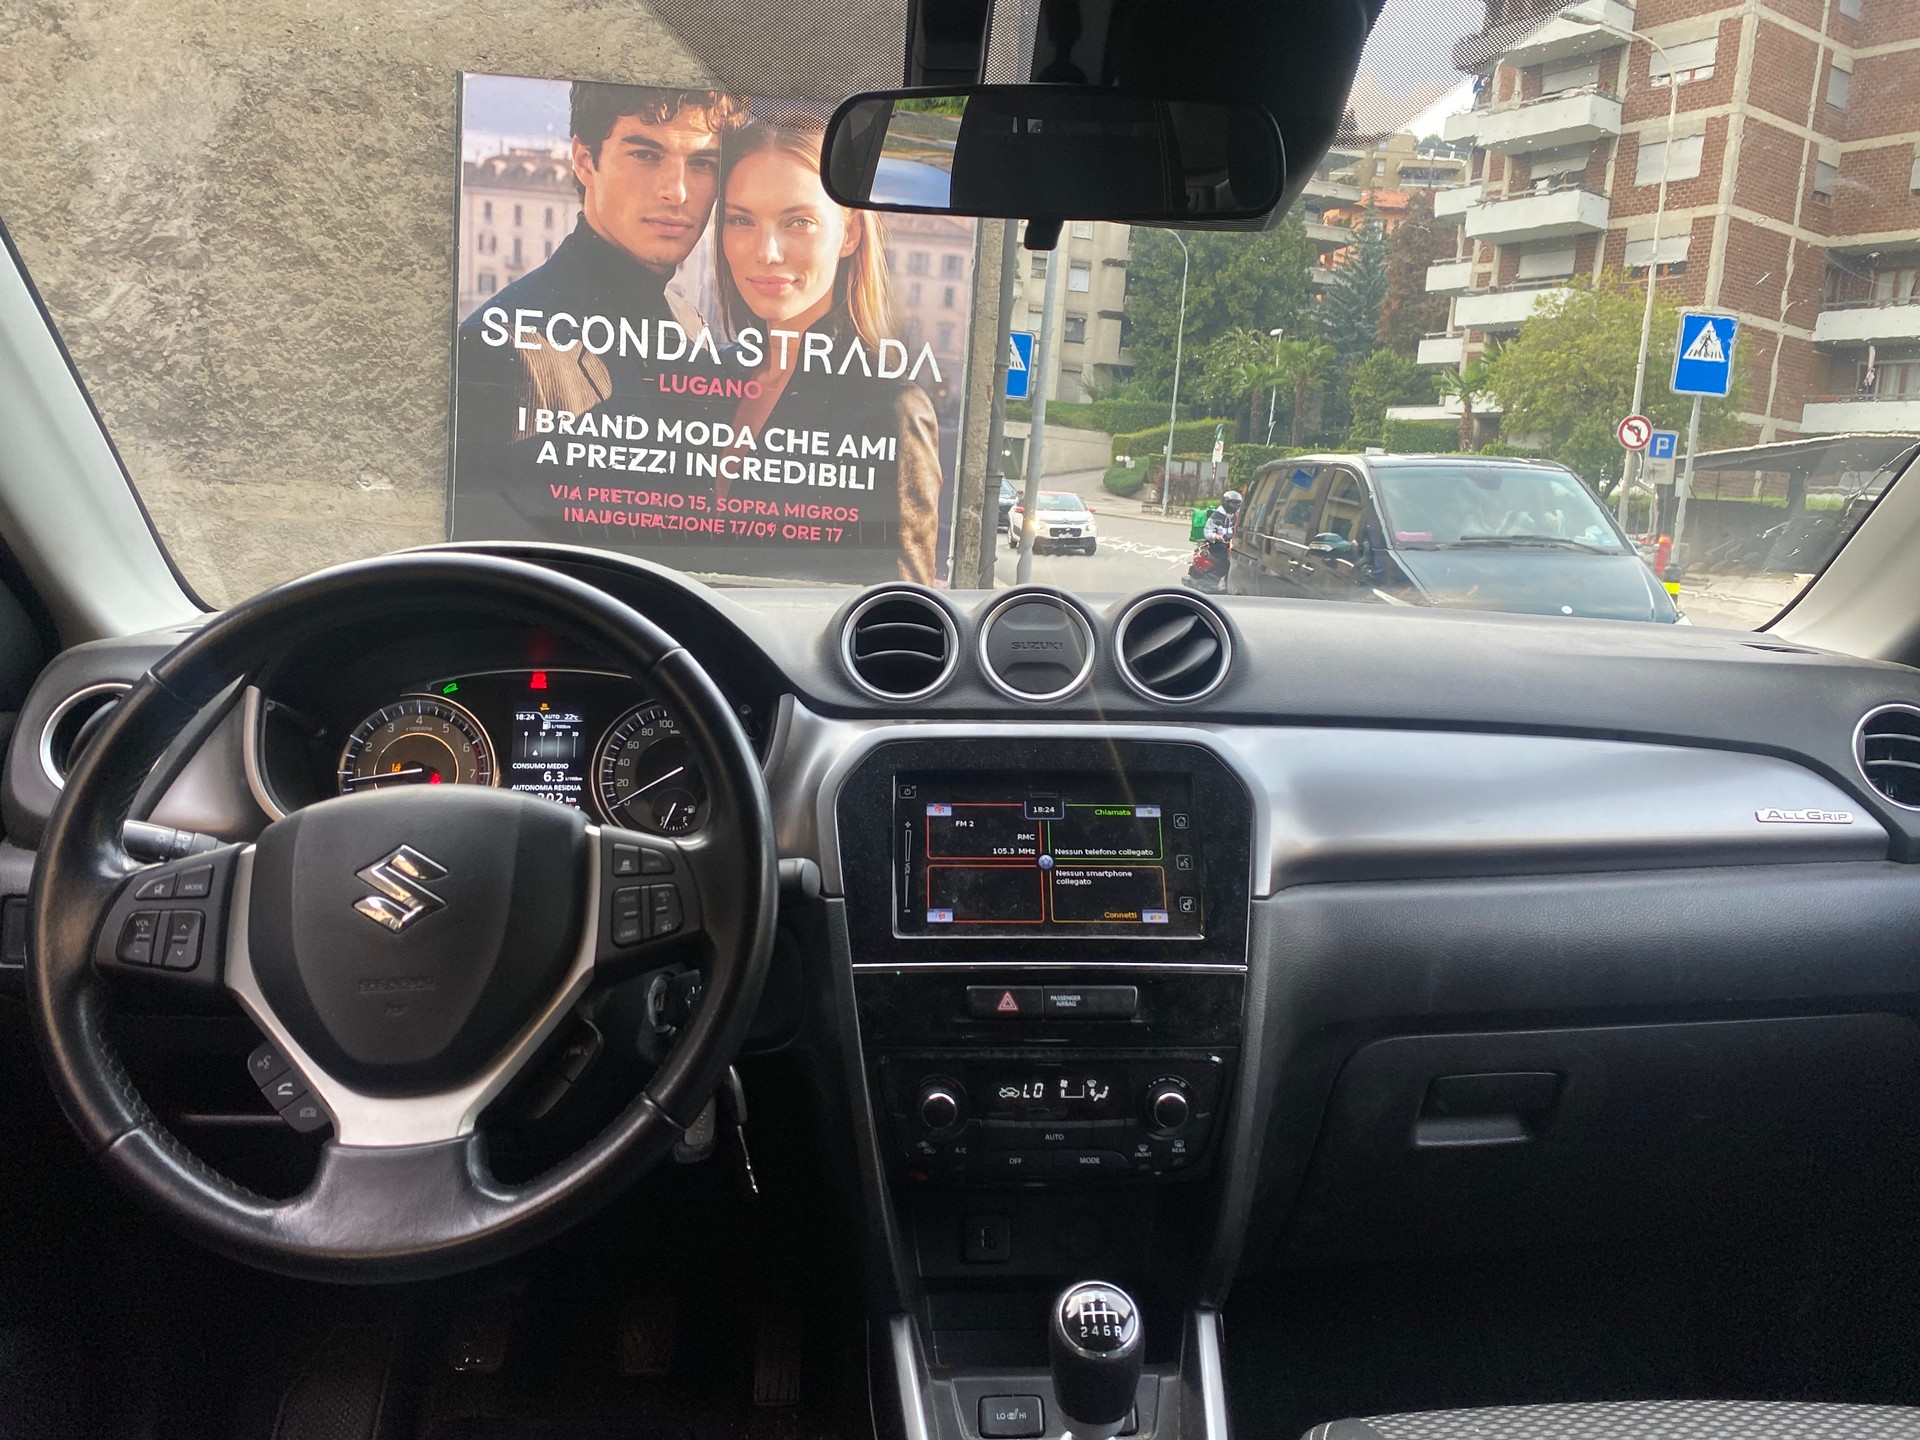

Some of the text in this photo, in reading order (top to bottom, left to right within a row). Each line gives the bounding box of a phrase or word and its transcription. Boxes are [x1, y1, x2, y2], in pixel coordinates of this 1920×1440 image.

[481, 306, 943, 383] SECONDA STRADA
[659, 373, 763, 399] LUGANO
[518, 406, 897, 462] I BRAND MODA CHE AMI
[1656, 437, 1670, 456] P
[536, 440, 876, 491] A PREZZI INCREDIBILI
[550, 484, 859, 523] VIA PRETORIO 15, SOPRA MIGROS
[564, 507, 844, 543] INAUGURAZIONE 17/09 ORE 17
[1010, 641, 1063, 650] SUZUKI
[416, 715, 424, 725] 4
[515, 713, 535, 721] 18:24
[387, 723, 395, 733] 3
[442, 723, 450, 733] 5
[659, 719, 673, 728] 100
[642, 728, 653, 736] 80
[365, 742, 373, 752] 2
[463, 743, 470, 752] 6
[627, 741, 639, 749] 60
[617, 758, 630, 766] 40
[357, 768, 361, 777] 1
[469, 769, 476, 779] 7
[543, 771, 564, 782] 6.3
[993, 847, 1015, 855] 105.3
[1085, 848, 1117, 856] telefono
[1118, 849, 1154, 857] collegato
[1055, 869, 1133, 878] Nessun smartphone
[1056, 878, 1092, 886] collegato
[1104, 911, 1137, 919] Connetti
[136, 919, 149, 927] VOL
[1009, 1157, 1022, 1165] OFF
[1080, 1156, 1100, 1164] MODE
[1080, 1325, 1122, 1338] 2 4 6 R
[996, 1412, 1006, 1420] LO
